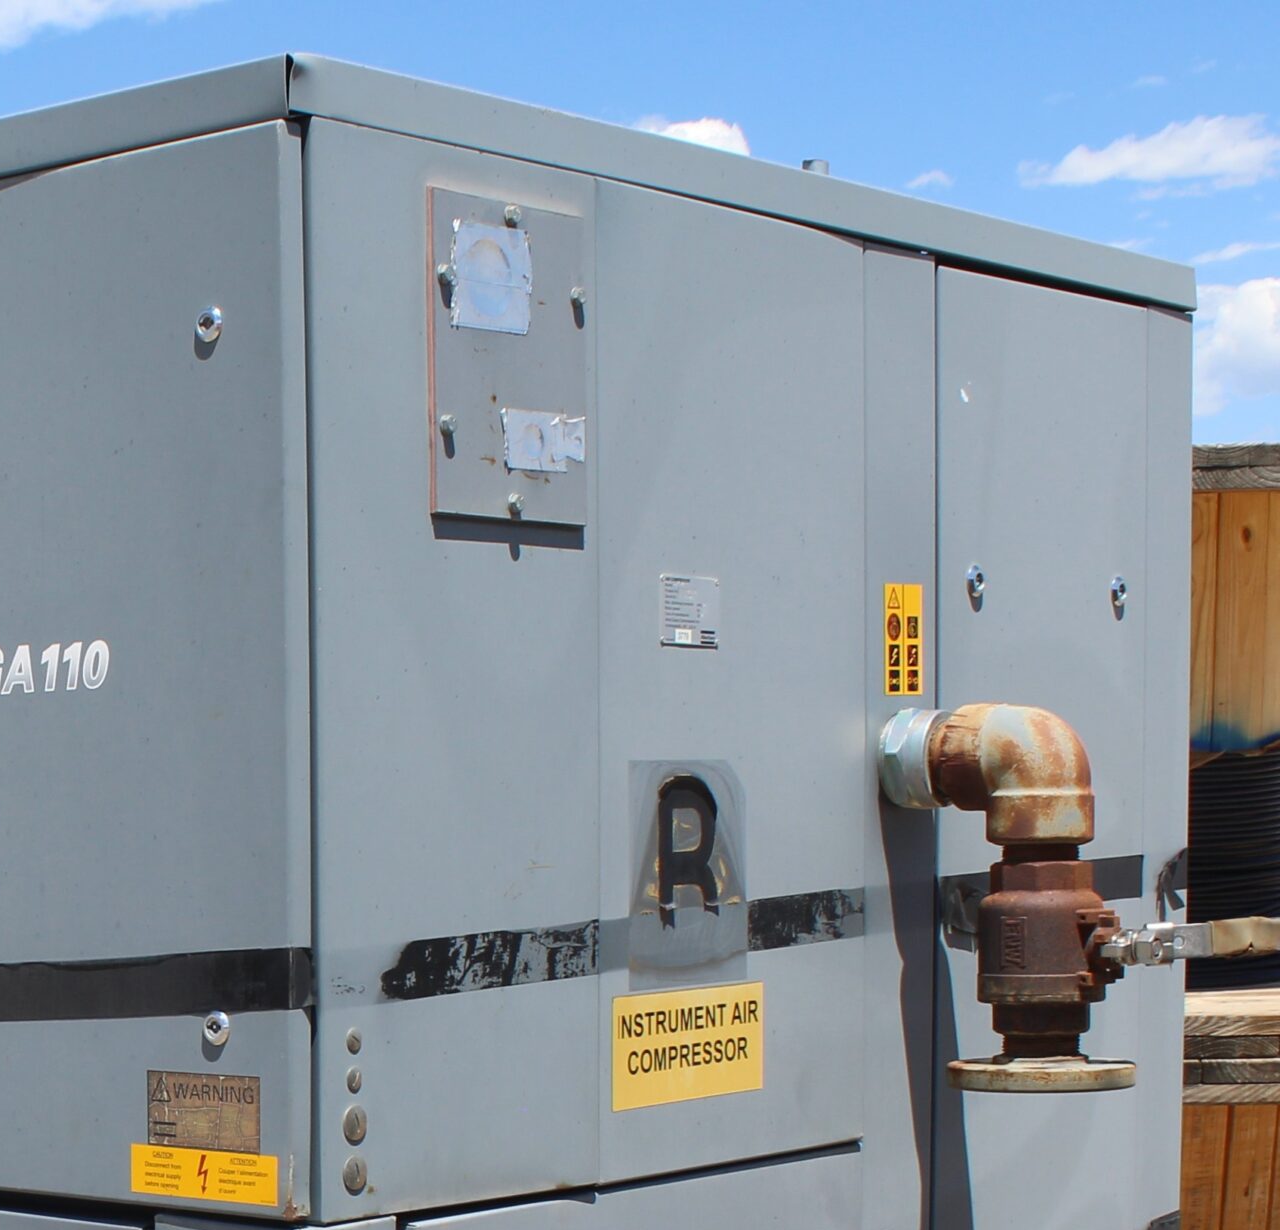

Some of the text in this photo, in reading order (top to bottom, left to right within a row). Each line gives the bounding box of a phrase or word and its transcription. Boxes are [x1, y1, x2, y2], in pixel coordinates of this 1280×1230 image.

[730, 1000, 759, 1026] AIR
[627, 1037, 749, 1075] COMPRESSOR
[173, 1082, 255, 1105] WARNING
